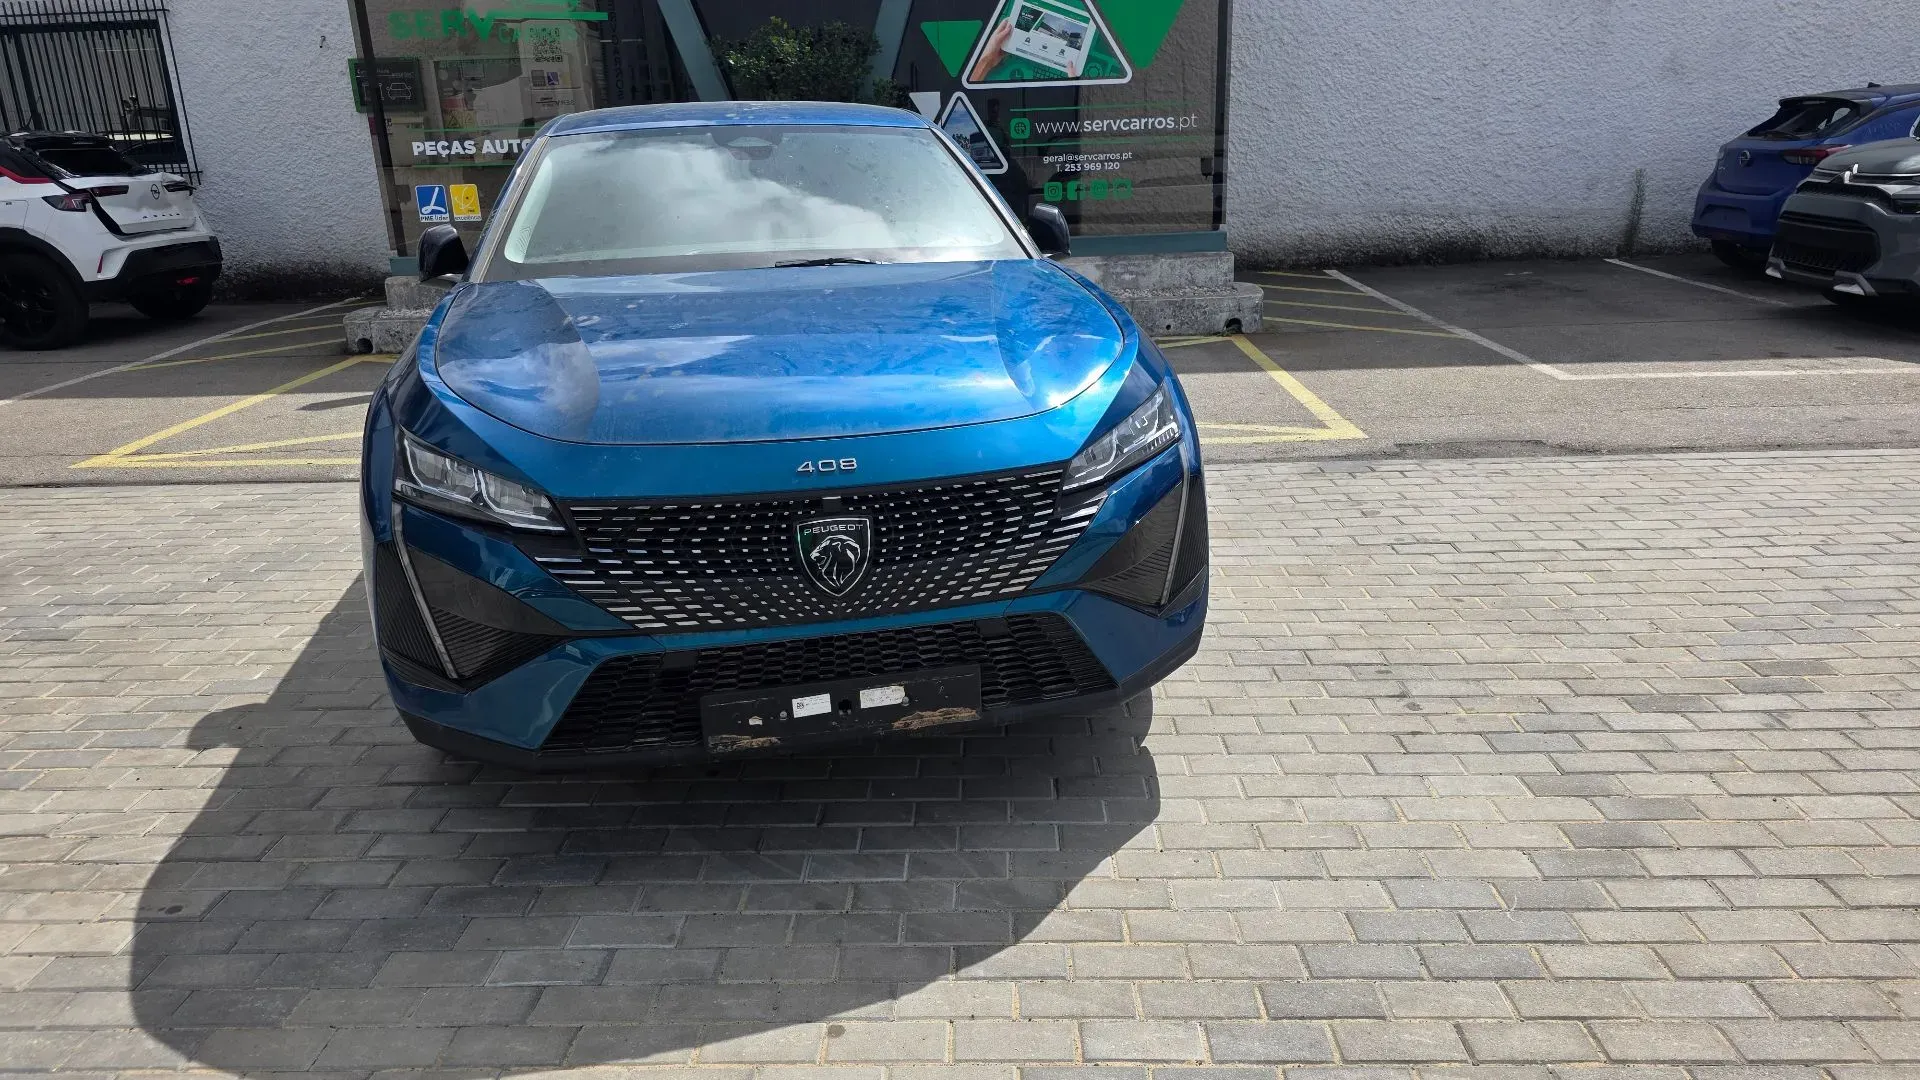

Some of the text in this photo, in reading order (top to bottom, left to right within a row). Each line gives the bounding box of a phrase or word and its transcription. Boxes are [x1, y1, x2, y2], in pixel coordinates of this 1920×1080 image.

[387, 7, 499, 41] SERV
[1035, 113, 1198, 134] www.servcarros.pt
[412, 140, 477, 158] PEÇAS
[1043, 152, 1132, 164] geral@servcarros.pt
[1065, 163, 1082, 172] 253
[1084, 163, 1101, 172] 969
[1104, 162, 1120, 170] 120
[797, 458, 857, 472] 408
[804, 523, 863, 535] PEUGEOT
